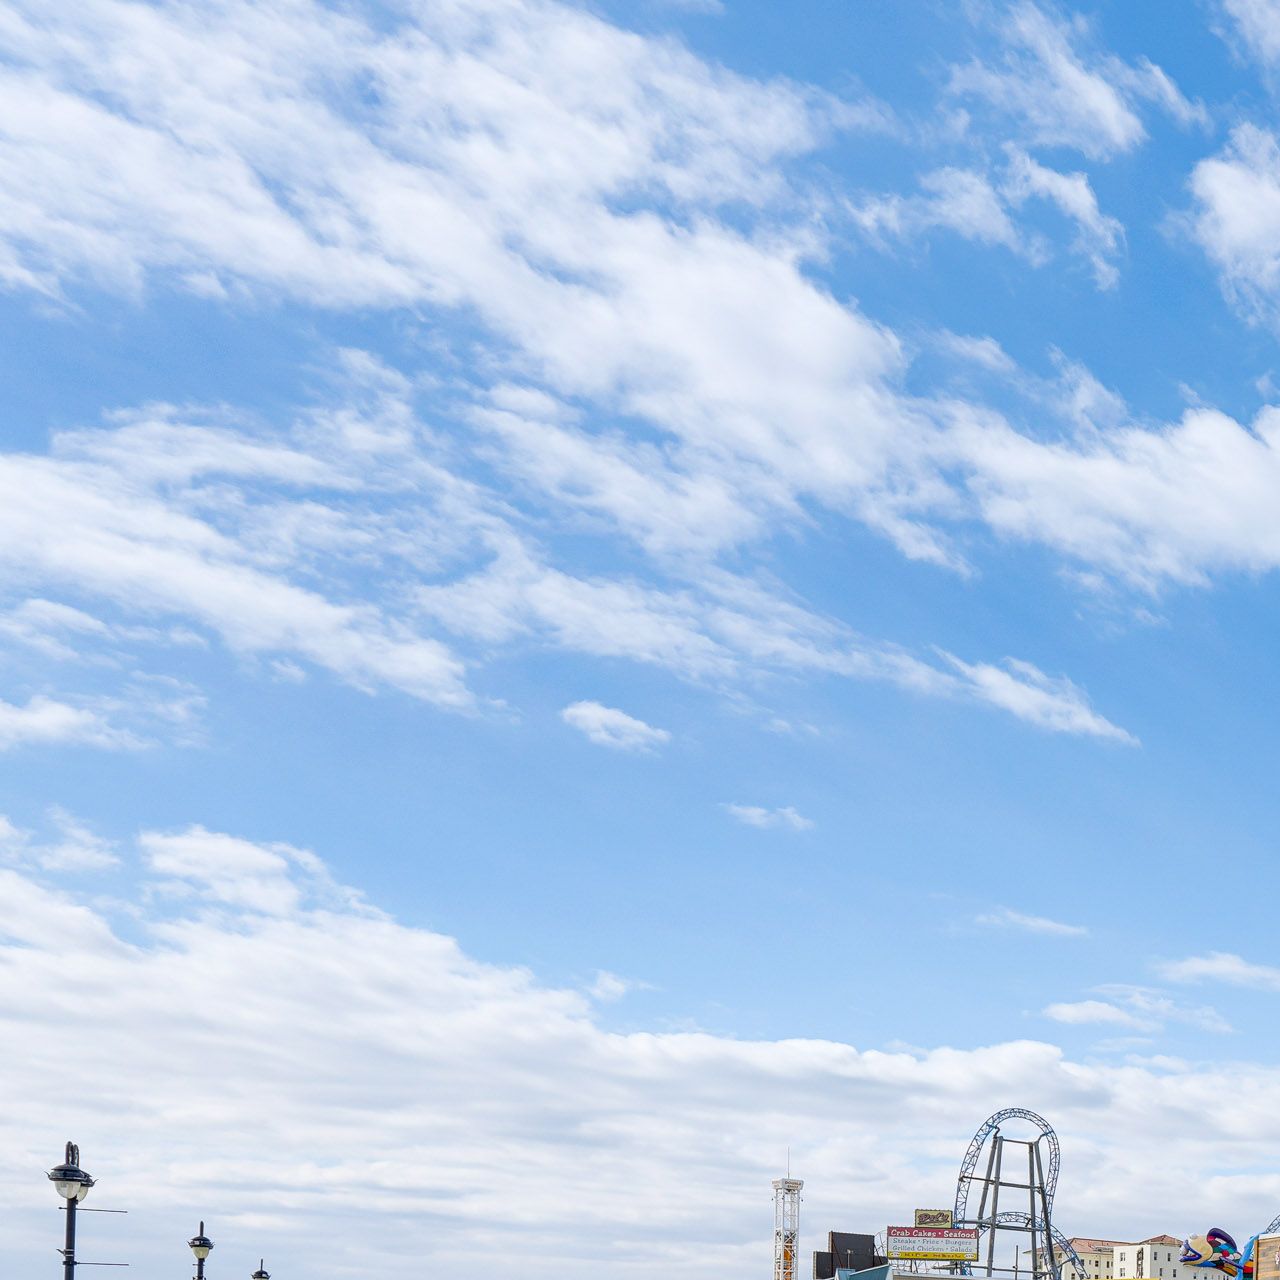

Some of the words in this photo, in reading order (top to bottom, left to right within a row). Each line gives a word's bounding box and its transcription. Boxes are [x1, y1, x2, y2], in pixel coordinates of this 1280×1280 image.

[890, 1229, 911, 1237] Crab
[912, 1230, 937, 1238] Cakes
[943, 1231, 976, 1239] Seafood
